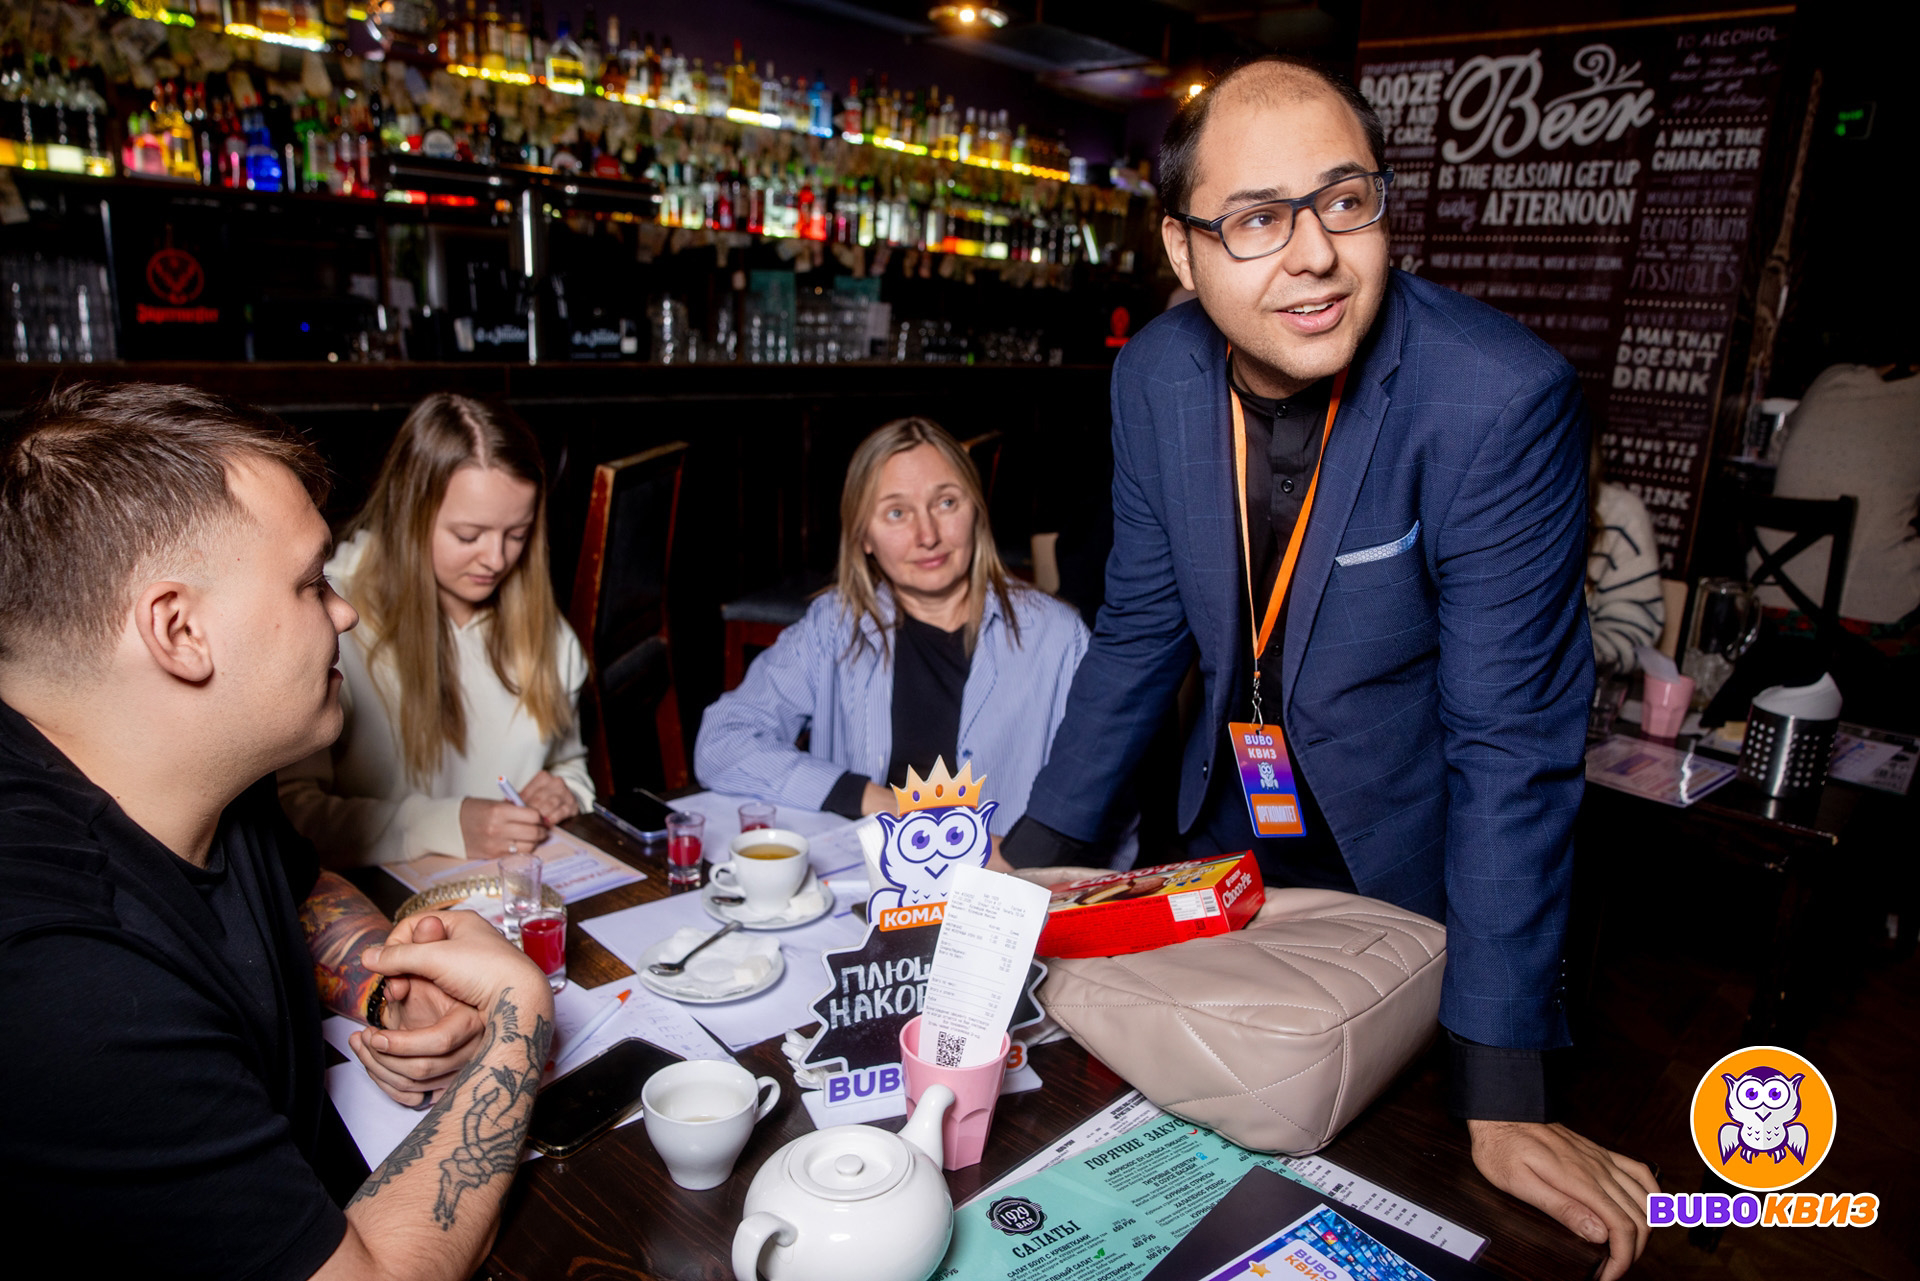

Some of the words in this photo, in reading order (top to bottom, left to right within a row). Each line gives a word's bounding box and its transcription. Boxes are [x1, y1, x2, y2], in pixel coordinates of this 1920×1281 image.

[1359, 72, 1444, 106] BOOZE
[1441, 46, 1655, 163] Beer
[1655, 130, 1666, 148] A
[1724, 127, 1766, 147] TRUE
[1651, 149, 1762, 171] CHARACTER
[1437, 165, 1456, 189] IS
[1458, 163, 1491, 190] THE
[1491, 162, 1562, 189] REASON
[1562, 162, 1573, 187] I
[1574, 160, 1614, 187] GET
[1613, 159, 1641, 186] UP
[1480, 188, 1637, 226] AFTERNOON
[1620, 325, 1633, 343] A
[1635, 325, 1675, 347] MAN
[1675, 330, 1725, 350] THAT
[1616, 343, 1718, 371] DOESN'T
[1611, 365, 1711, 396] DRINK
[1244, 734, 1273, 746] BUBO
[1248, 748, 1277, 759] КВИЗ
[884, 905, 947, 928] КОМА
[829, 1067, 903, 1103] BUB
[1164, 1135, 1189, 1148] ПИКАНТЕ
[1084, 1137, 1144, 1170] ГОРЯЧИЕ
[1170, 1156, 1198, 1172] КРЕВЕТКИ
[1175, 1163, 1197, 1176] ВАСАБИ
[1164, 1184, 1191, 1200] КУРИНЫЕ
[1174, 1189, 1207, 1208] ХАЛАПЕНОС
[1000, 1206, 1030, 1226] 1929
[1015, 1217, 1035, 1229] BAR
[1012, 1220, 1081, 1258] САЛАТЫ
[1142, 1234, 1156, 1243] РУБ
[1007, 1265, 1029, 1278] САЛАТ
[1027, 1256, 1046, 1268] БОУЛ
[1050, 1234, 1091, 1256] КРЕВЕТКАМИ
[1157, 1246, 1171, 1254] РУБ
[1072, 1257, 1094, 1270] САЛАТ
[1294, 1249, 1337, 1280] BUBO
